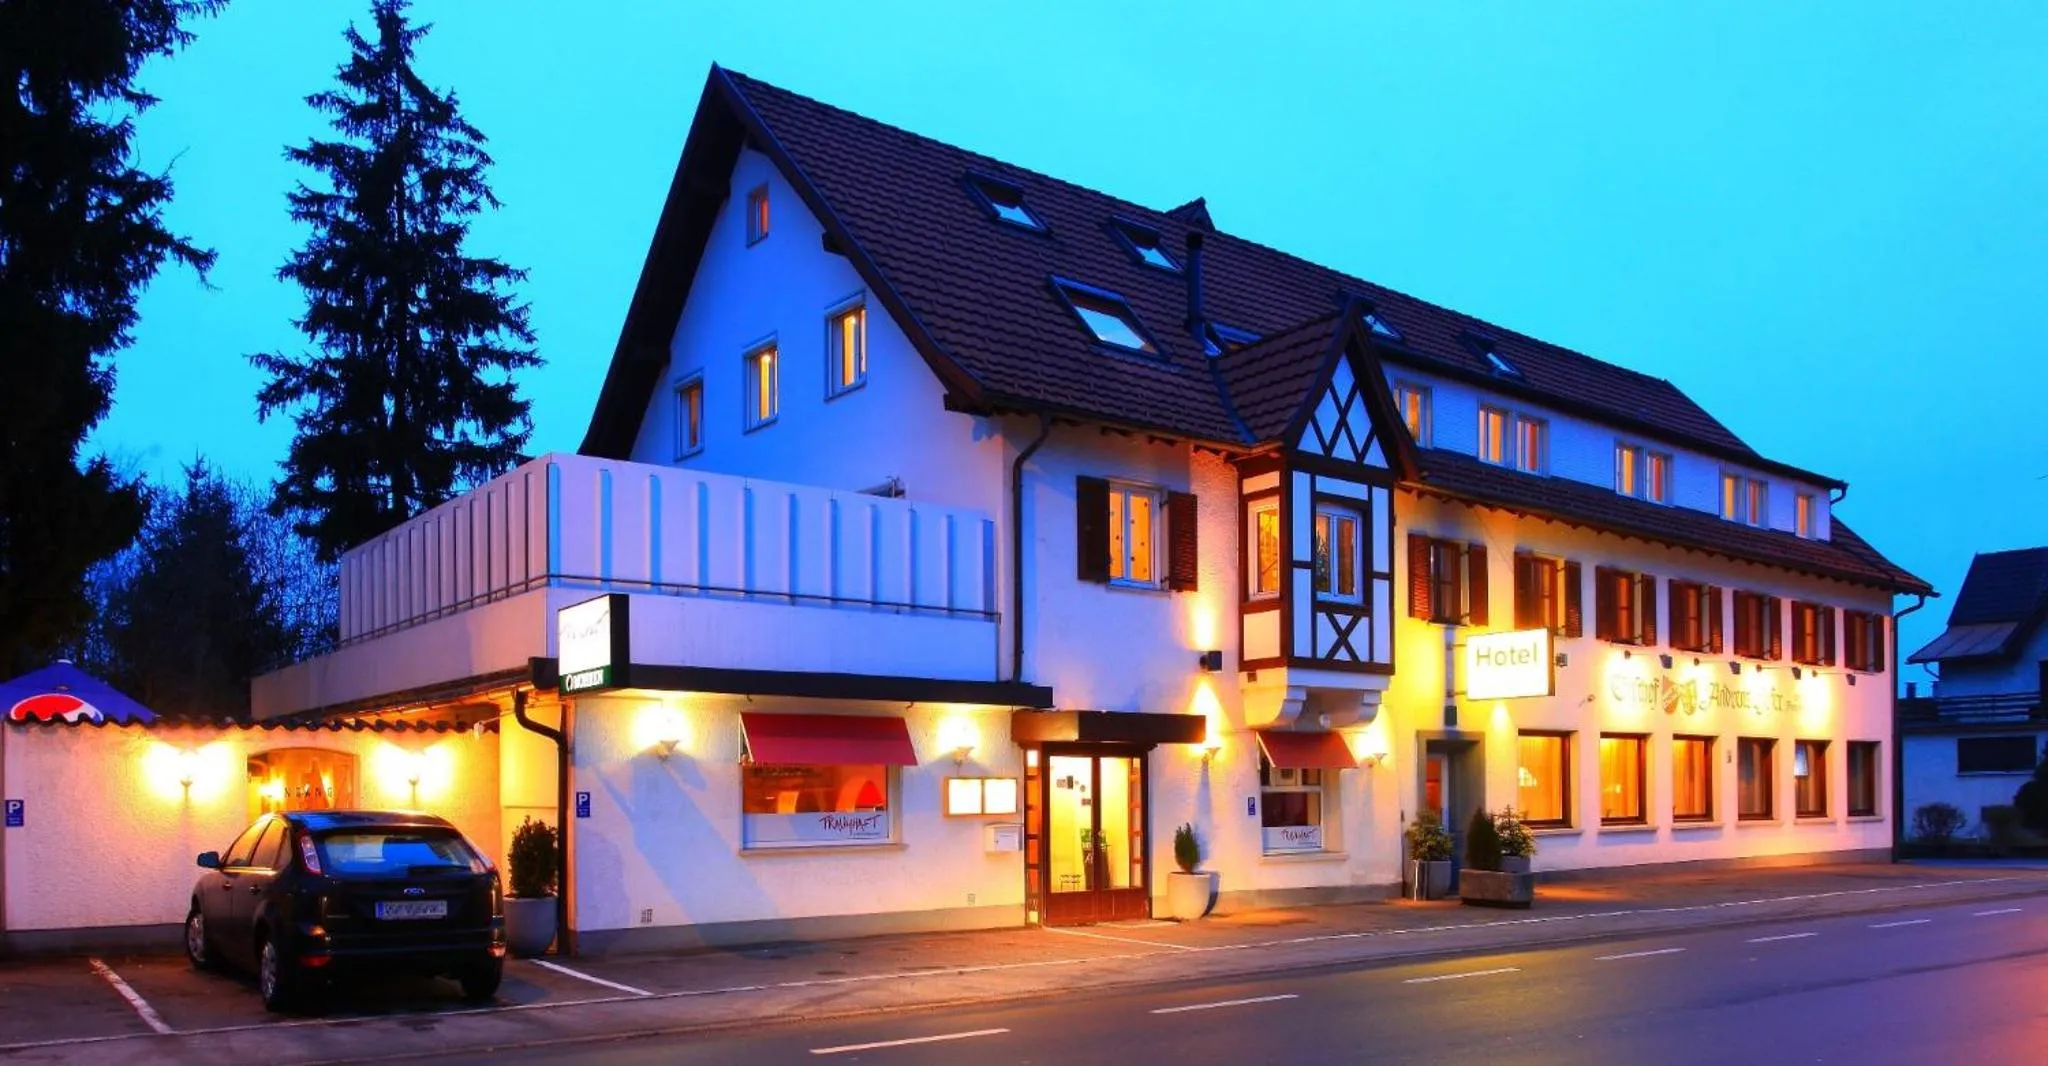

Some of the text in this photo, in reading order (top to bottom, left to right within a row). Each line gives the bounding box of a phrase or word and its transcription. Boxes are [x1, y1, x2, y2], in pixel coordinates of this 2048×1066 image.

[1476, 642, 1538, 666] Hotel
[579, 794, 588, 806] P
[8, 801, 21, 814] P
